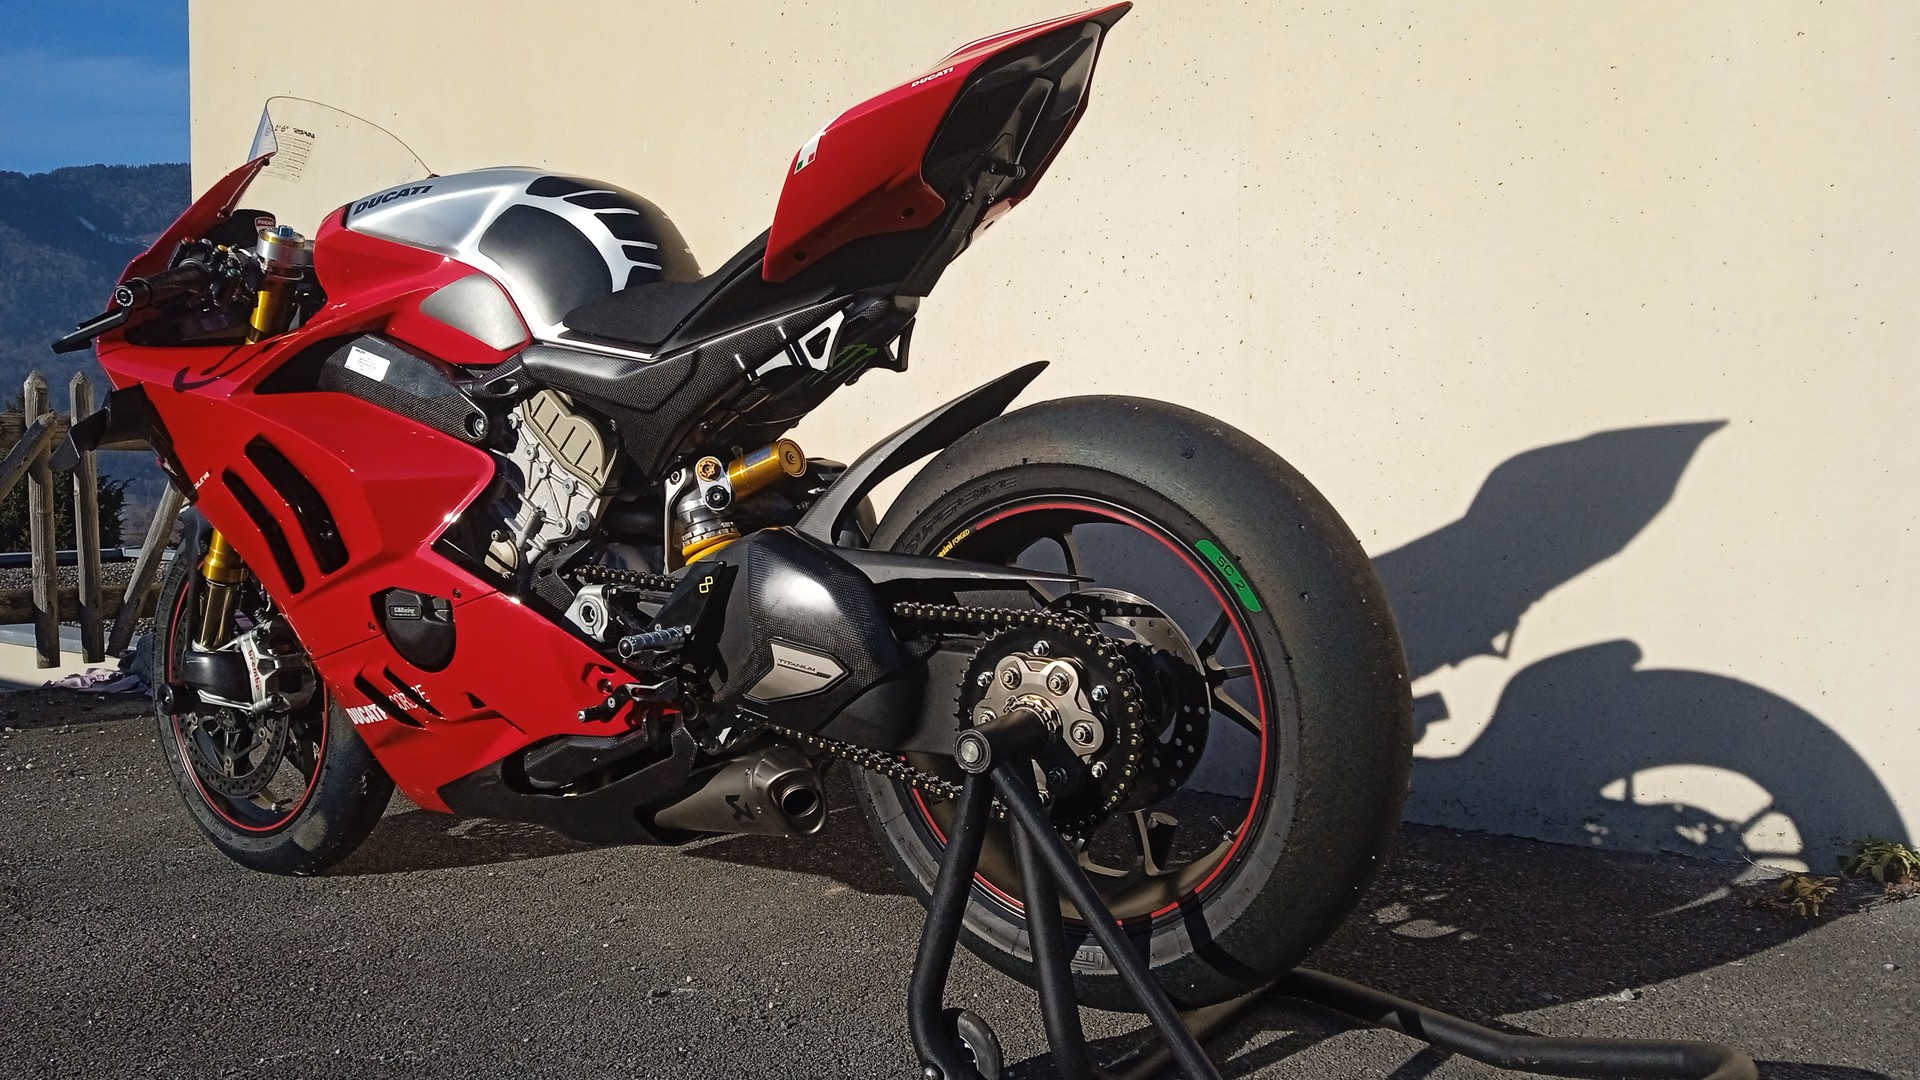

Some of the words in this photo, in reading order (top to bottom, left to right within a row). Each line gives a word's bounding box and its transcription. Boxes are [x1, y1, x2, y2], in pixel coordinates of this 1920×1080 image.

[911, 66, 954, 88] DUCATI
[353, 185, 433, 215] DUCATI
[902, 475, 1018, 555] SUPERBIKE
[952, 528, 971, 546] FORGED
[1216, 555, 1235, 577] SC
[1234, 579, 1246, 592] 2
[247, 648, 260, 691] brembo
[777, 658, 816, 672] TITANIUM
[345, 703, 389, 725] DUCATI
